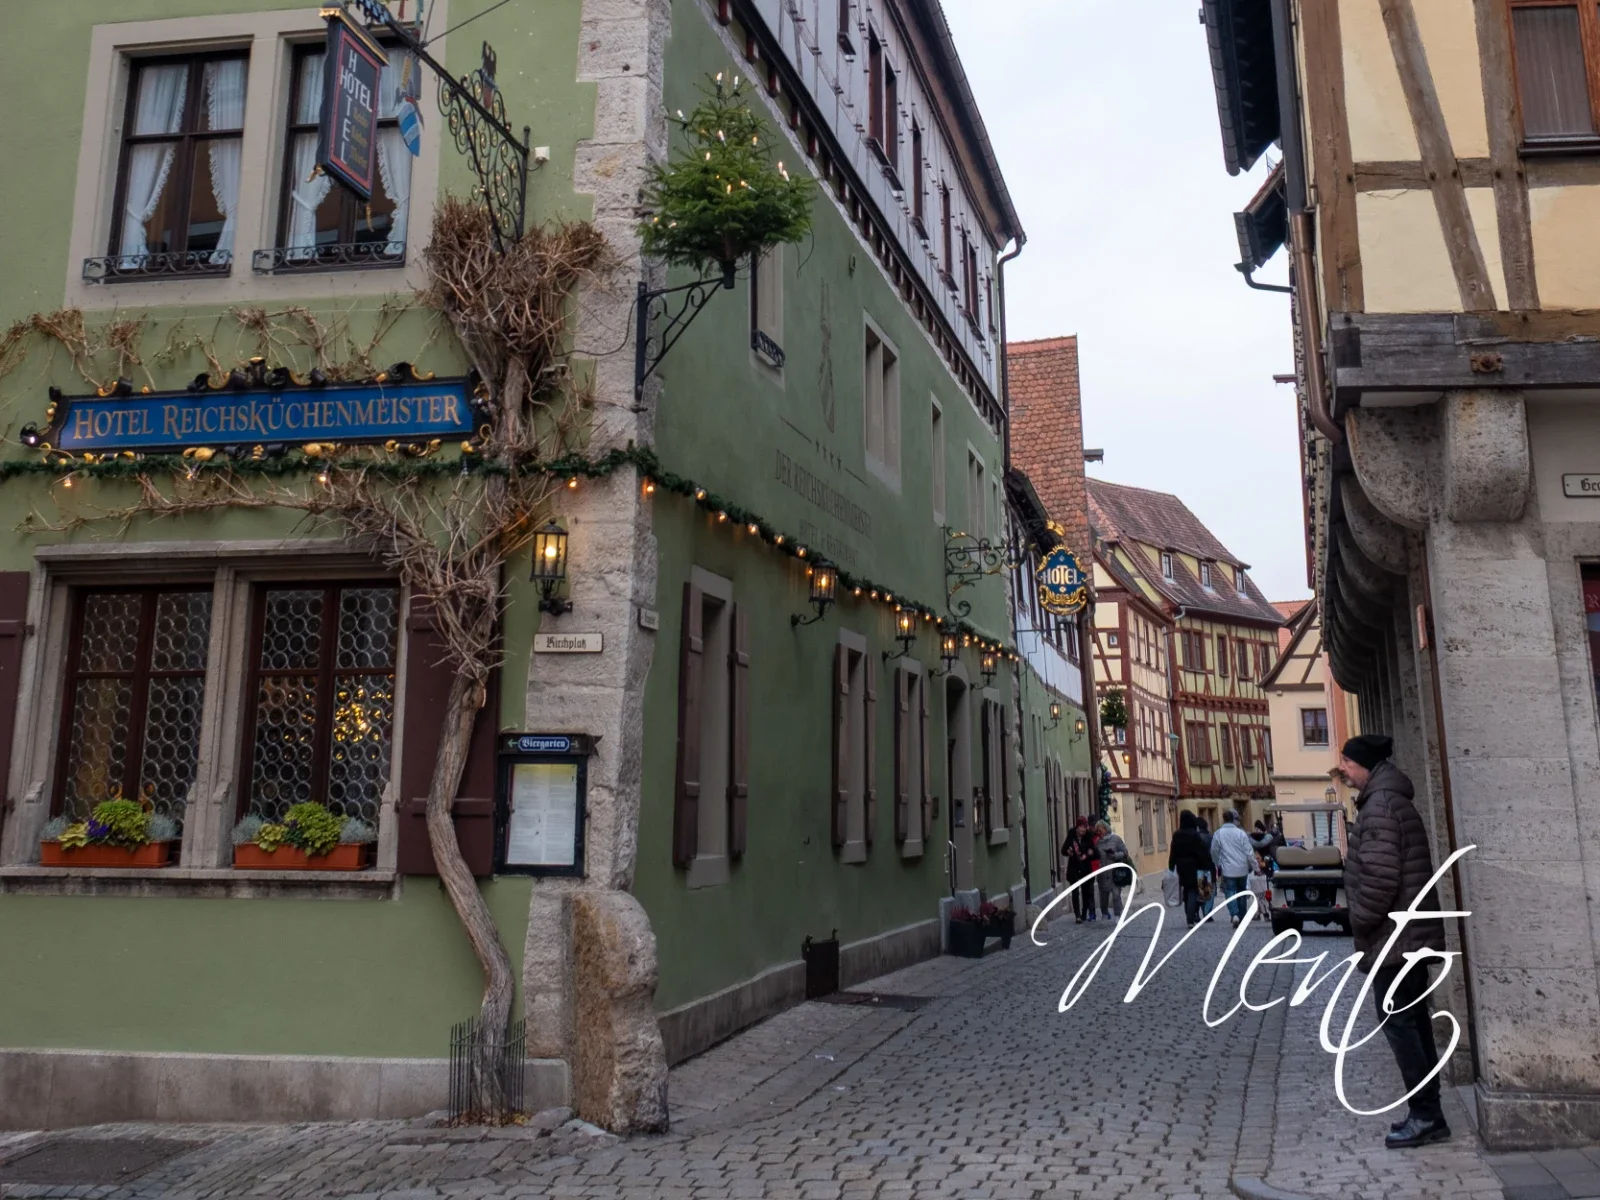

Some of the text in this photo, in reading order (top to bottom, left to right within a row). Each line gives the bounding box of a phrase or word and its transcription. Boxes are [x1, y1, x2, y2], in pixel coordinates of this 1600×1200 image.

[340, 65, 373, 112] HOTEL
[74, 407, 153, 439] HOTEL
[1042, 565, 1082, 585] HOTEL
[522, 738, 566, 750] Biergarten
